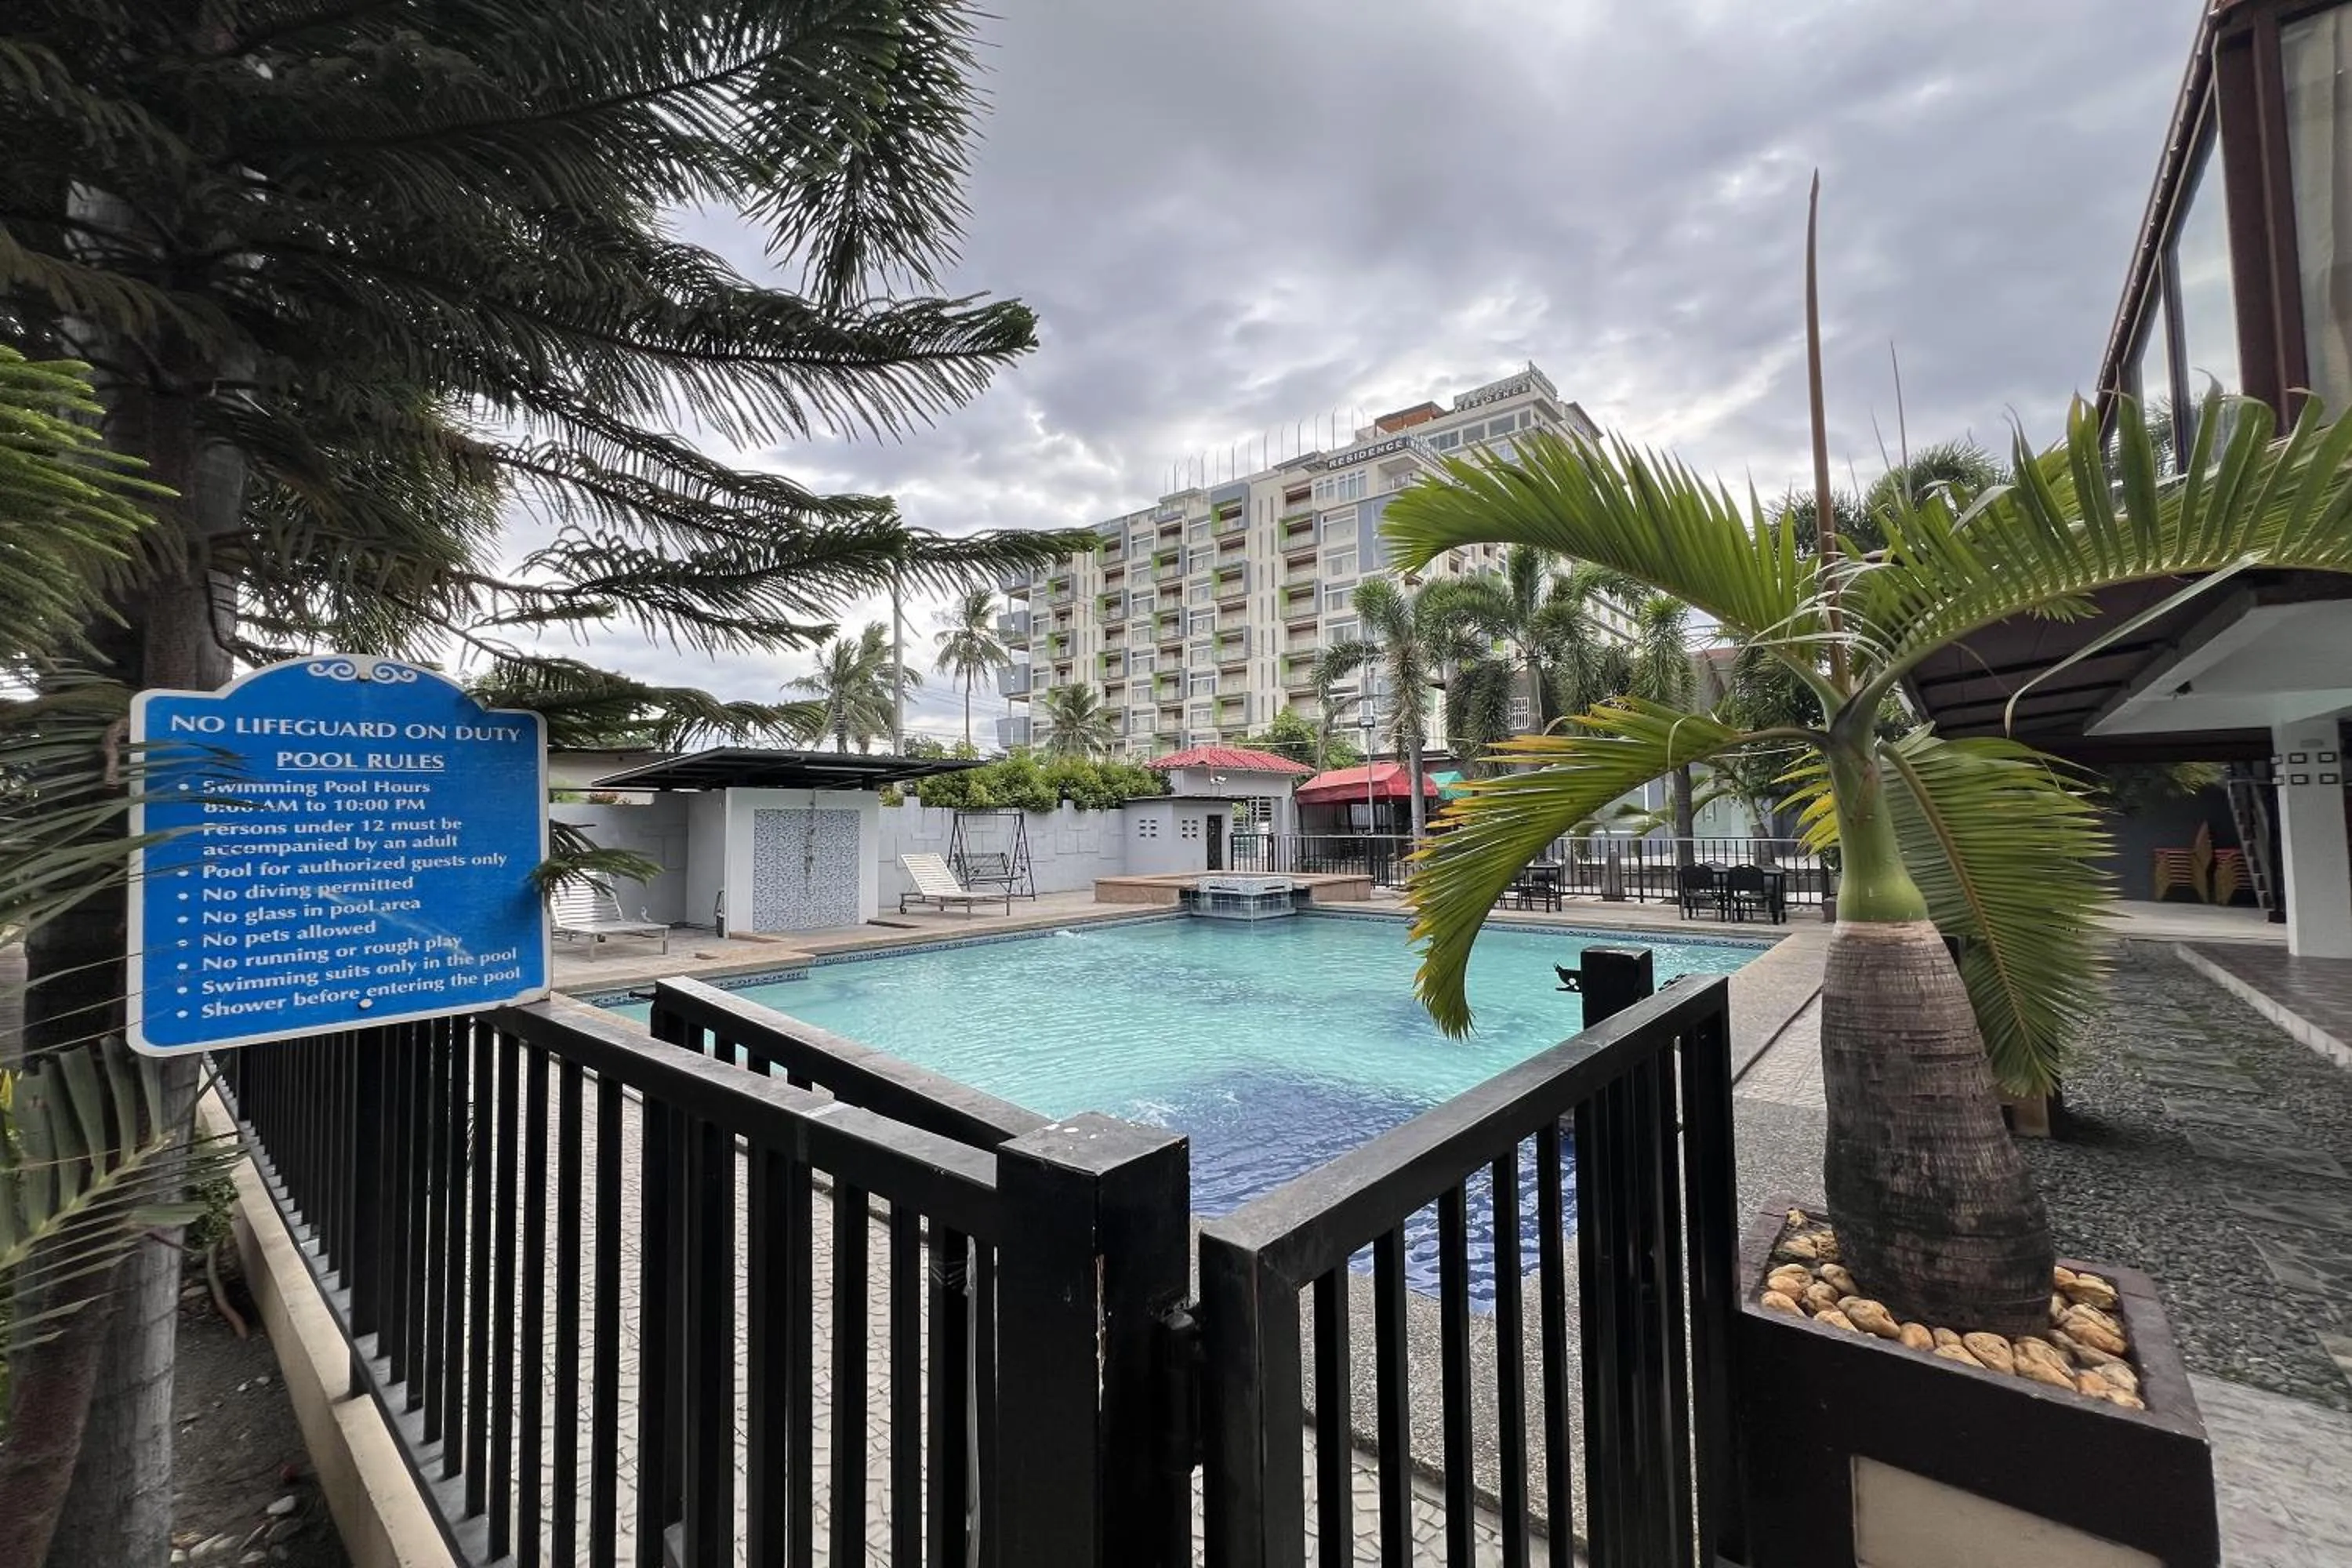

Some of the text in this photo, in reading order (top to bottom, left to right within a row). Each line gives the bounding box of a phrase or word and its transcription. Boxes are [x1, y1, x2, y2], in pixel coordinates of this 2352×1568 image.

[1328, 439, 1403, 469] RESIDENCE
[170, 714, 521, 742] NO LIFEGUARD ON DUTY
[276, 752, 445, 769] POOL RULES
[202, 780, 431, 797] Swimming Pool Hours
[260, 799, 299, 812] AM
[306, 800, 327, 812] to
[334, 798, 390, 811] 10:00
[394, 798, 426, 811] PM
[202, 817, 463, 836] Persons under 12 must be
[202, 834, 458, 857] accompanied by an adult
[202, 852, 508, 879] Pool for authorized guests only
[202, 876, 415, 902] No diving permitted
[202, 899, 422, 926] No glass in pool area
[202, 920, 376, 949] No pets allowed
[202, 935, 463, 971] No running or rough play
[201, 946, 517, 995] Swimming suits only in the pool
[201, 967, 521, 1019] Shower before entering the pool
